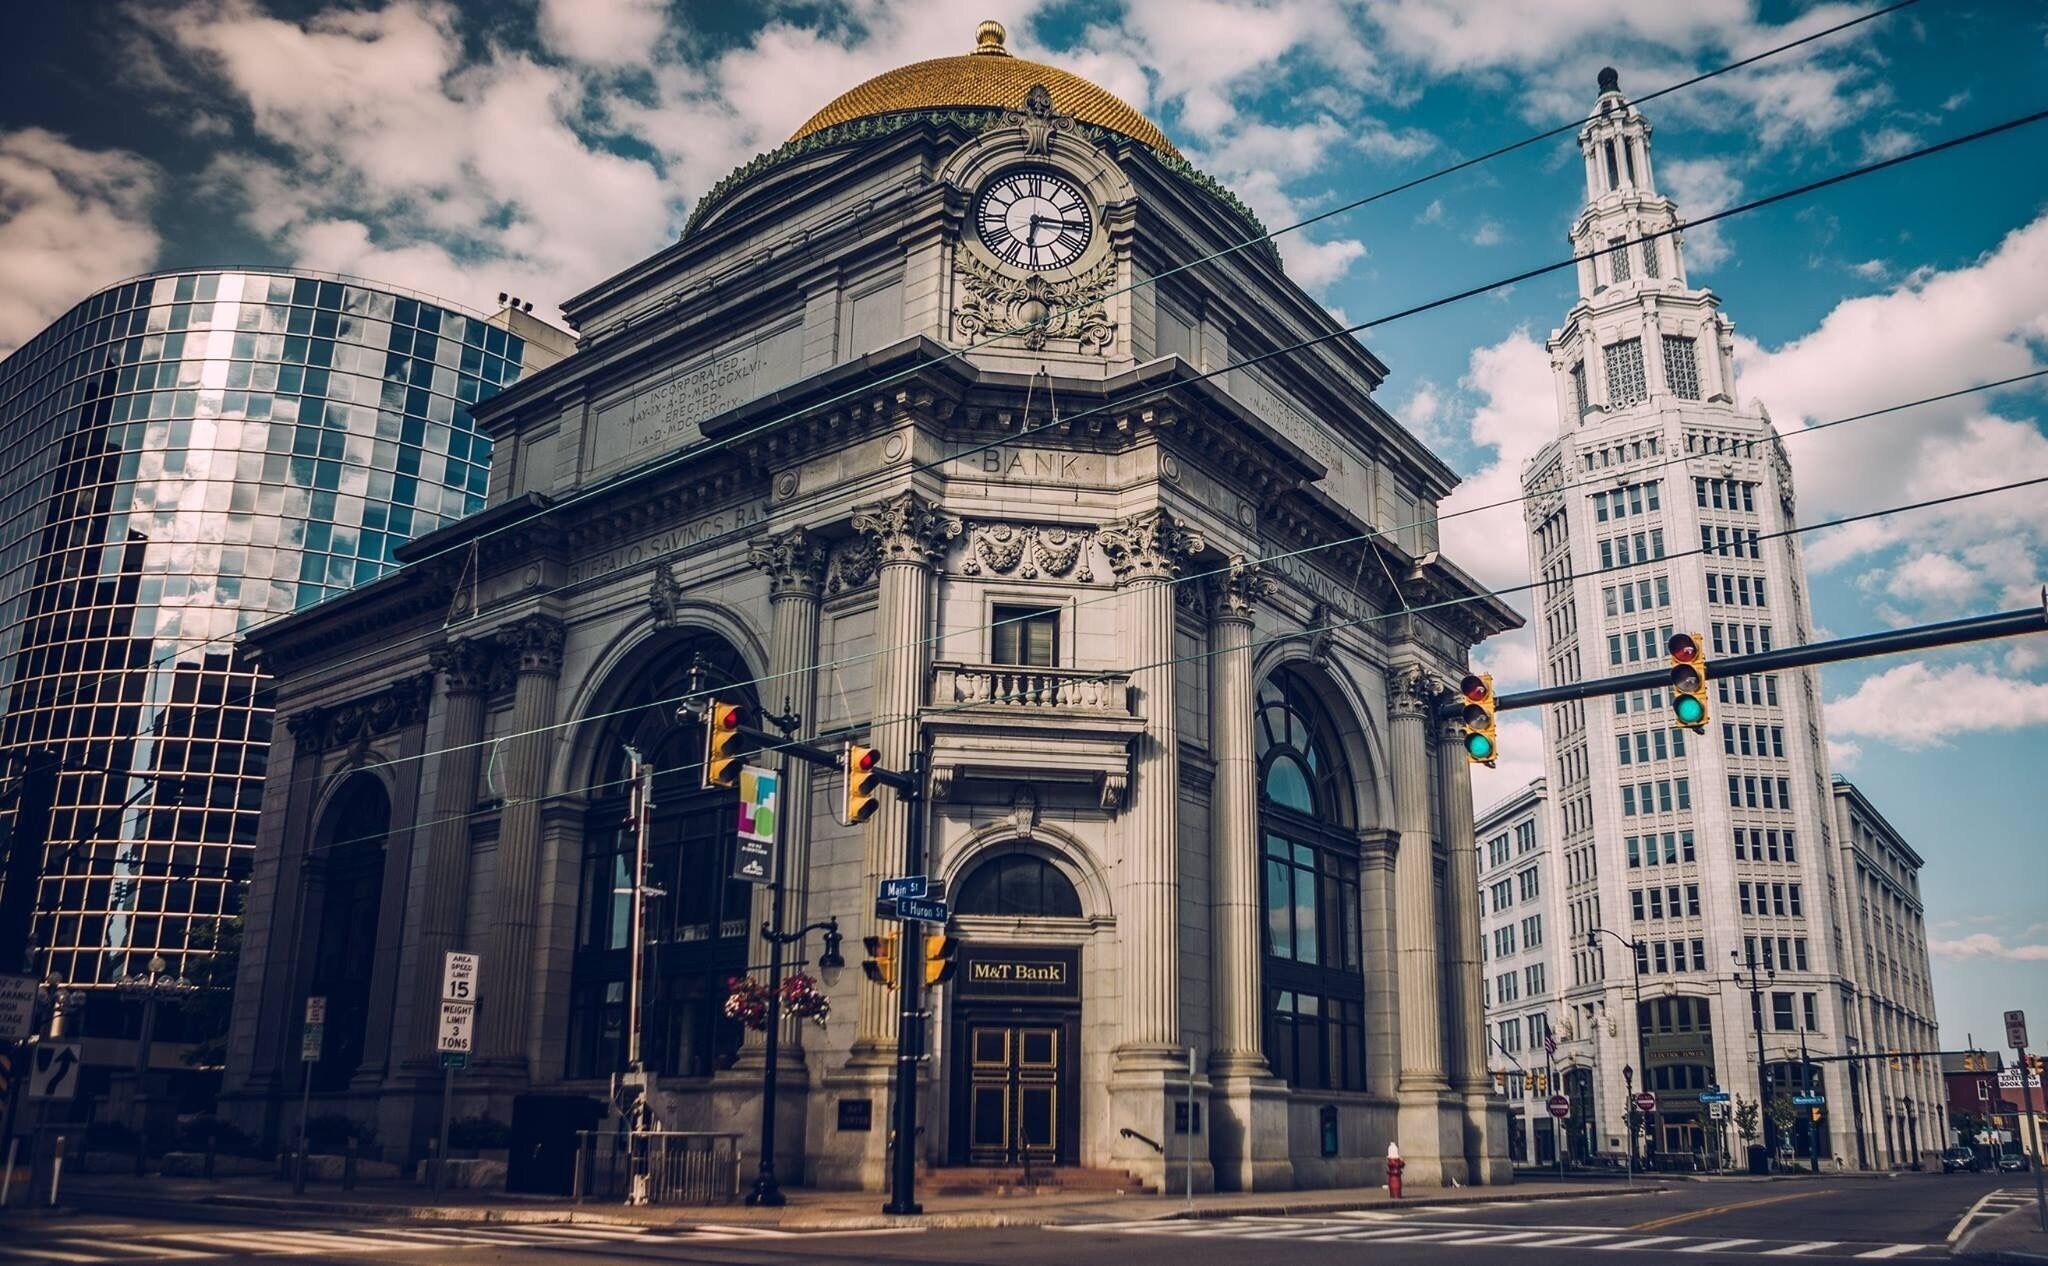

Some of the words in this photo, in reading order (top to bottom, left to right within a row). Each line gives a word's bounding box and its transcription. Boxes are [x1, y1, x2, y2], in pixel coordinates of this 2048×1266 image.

[650, 357, 738, 401] INCORPORATED
[665, 393, 718, 423] ERECTED
[983, 449, 1080, 480] BANK
[650, 517, 724, 553] SAVINGS
[1299, 564, 1349, 613] SAVINGS
[888, 882, 907, 896] Main
[910, 882, 919, 893] St
[902, 901, 906, 912] E
[910, 901, 933, 917] Huron
[936, 907, 944, 918] St
[451, 963, 472, 971] SPEED
[452, 970, 469, 978] LIMIT
[974, 963, 1012, 979] M&T
[1015, 964, 1060, 980] Bank
[450, 981, 469, 998] 15
[443, 1003, 472, 1014] WEIGHT
[446, 1016, 466, 1025] LIMIT
[453, 1026, 459, 1036] 3
[442, 1037, 468, 1049] TONS
